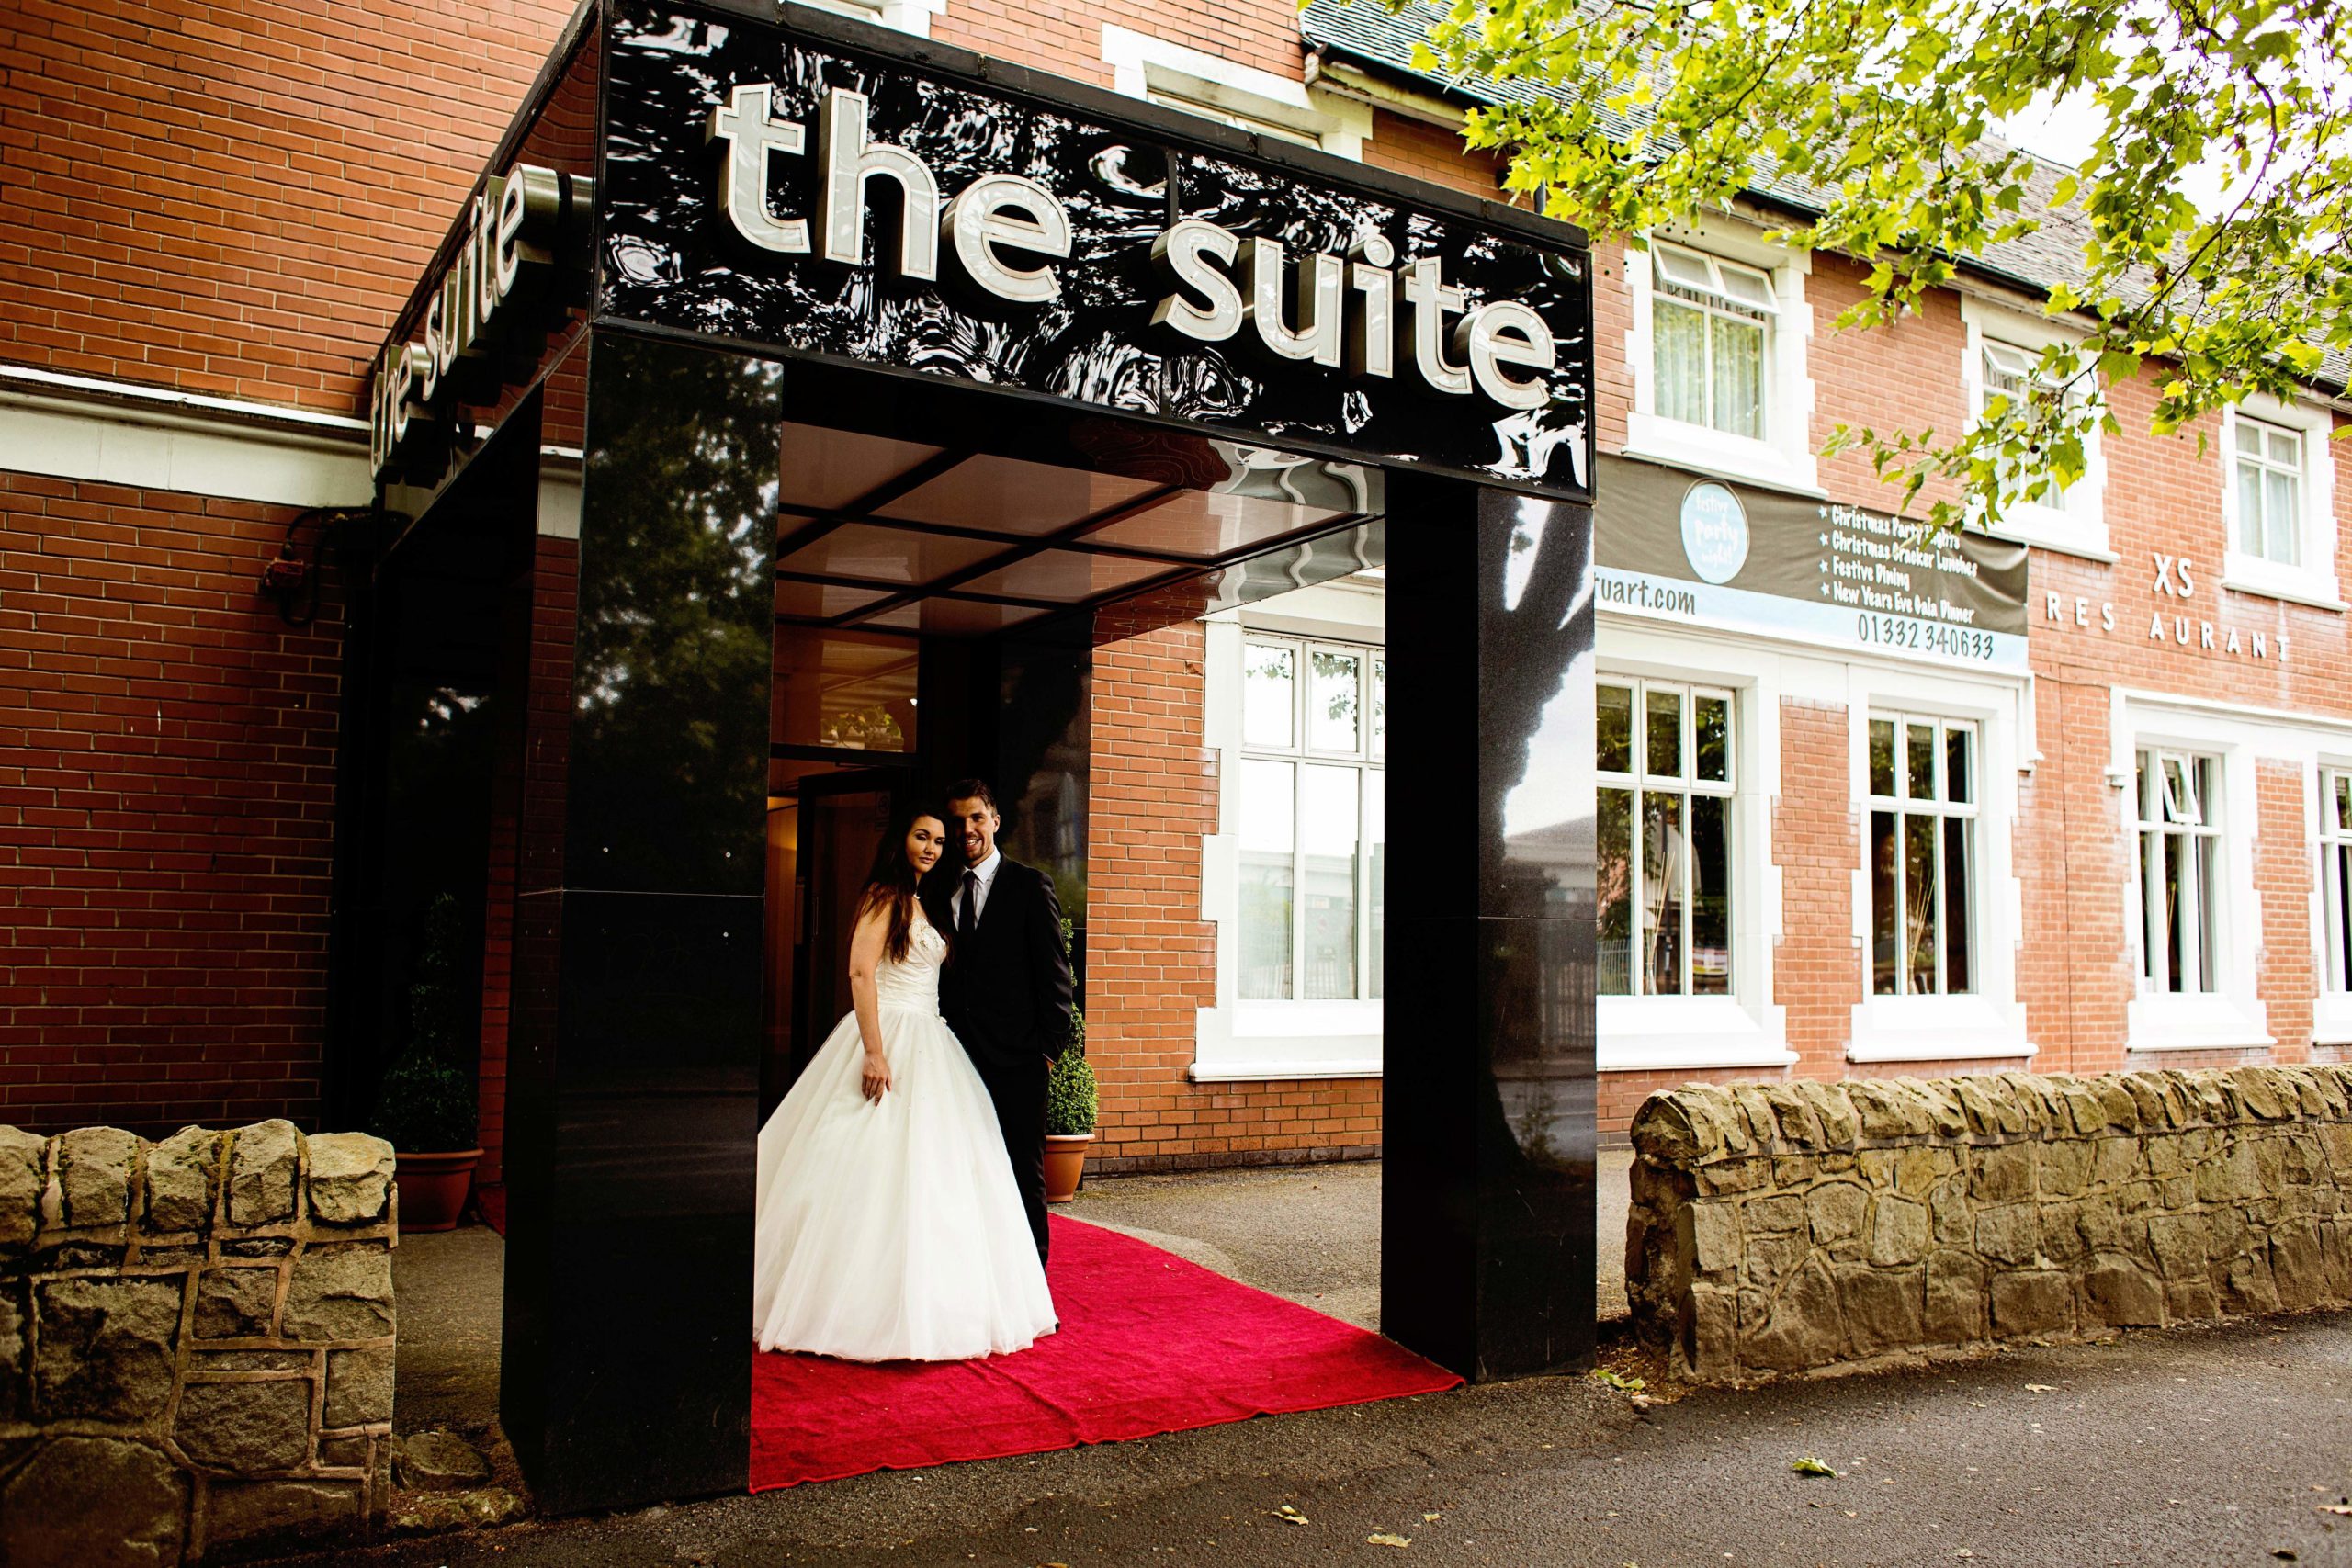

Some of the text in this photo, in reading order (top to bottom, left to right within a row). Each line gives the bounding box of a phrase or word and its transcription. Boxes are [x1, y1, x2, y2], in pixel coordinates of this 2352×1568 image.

[707, 82, 1557, 412] the suite
[369, 163, 526, 482] the suite
[1831, 504, 1890, 536] Christmas
[1892, 517, 1923, 545] Party
[1831, 530, 1978, 578] Christmas Cracker Lunches
[1832, 555, 1910, 592] Festive Dining
[2153, 552, 2194, 598] XS
[1832, 581, 1975, 624] New Years Eve Gala Dinner
[1858, 613, 1994, 660] 01332 340633
